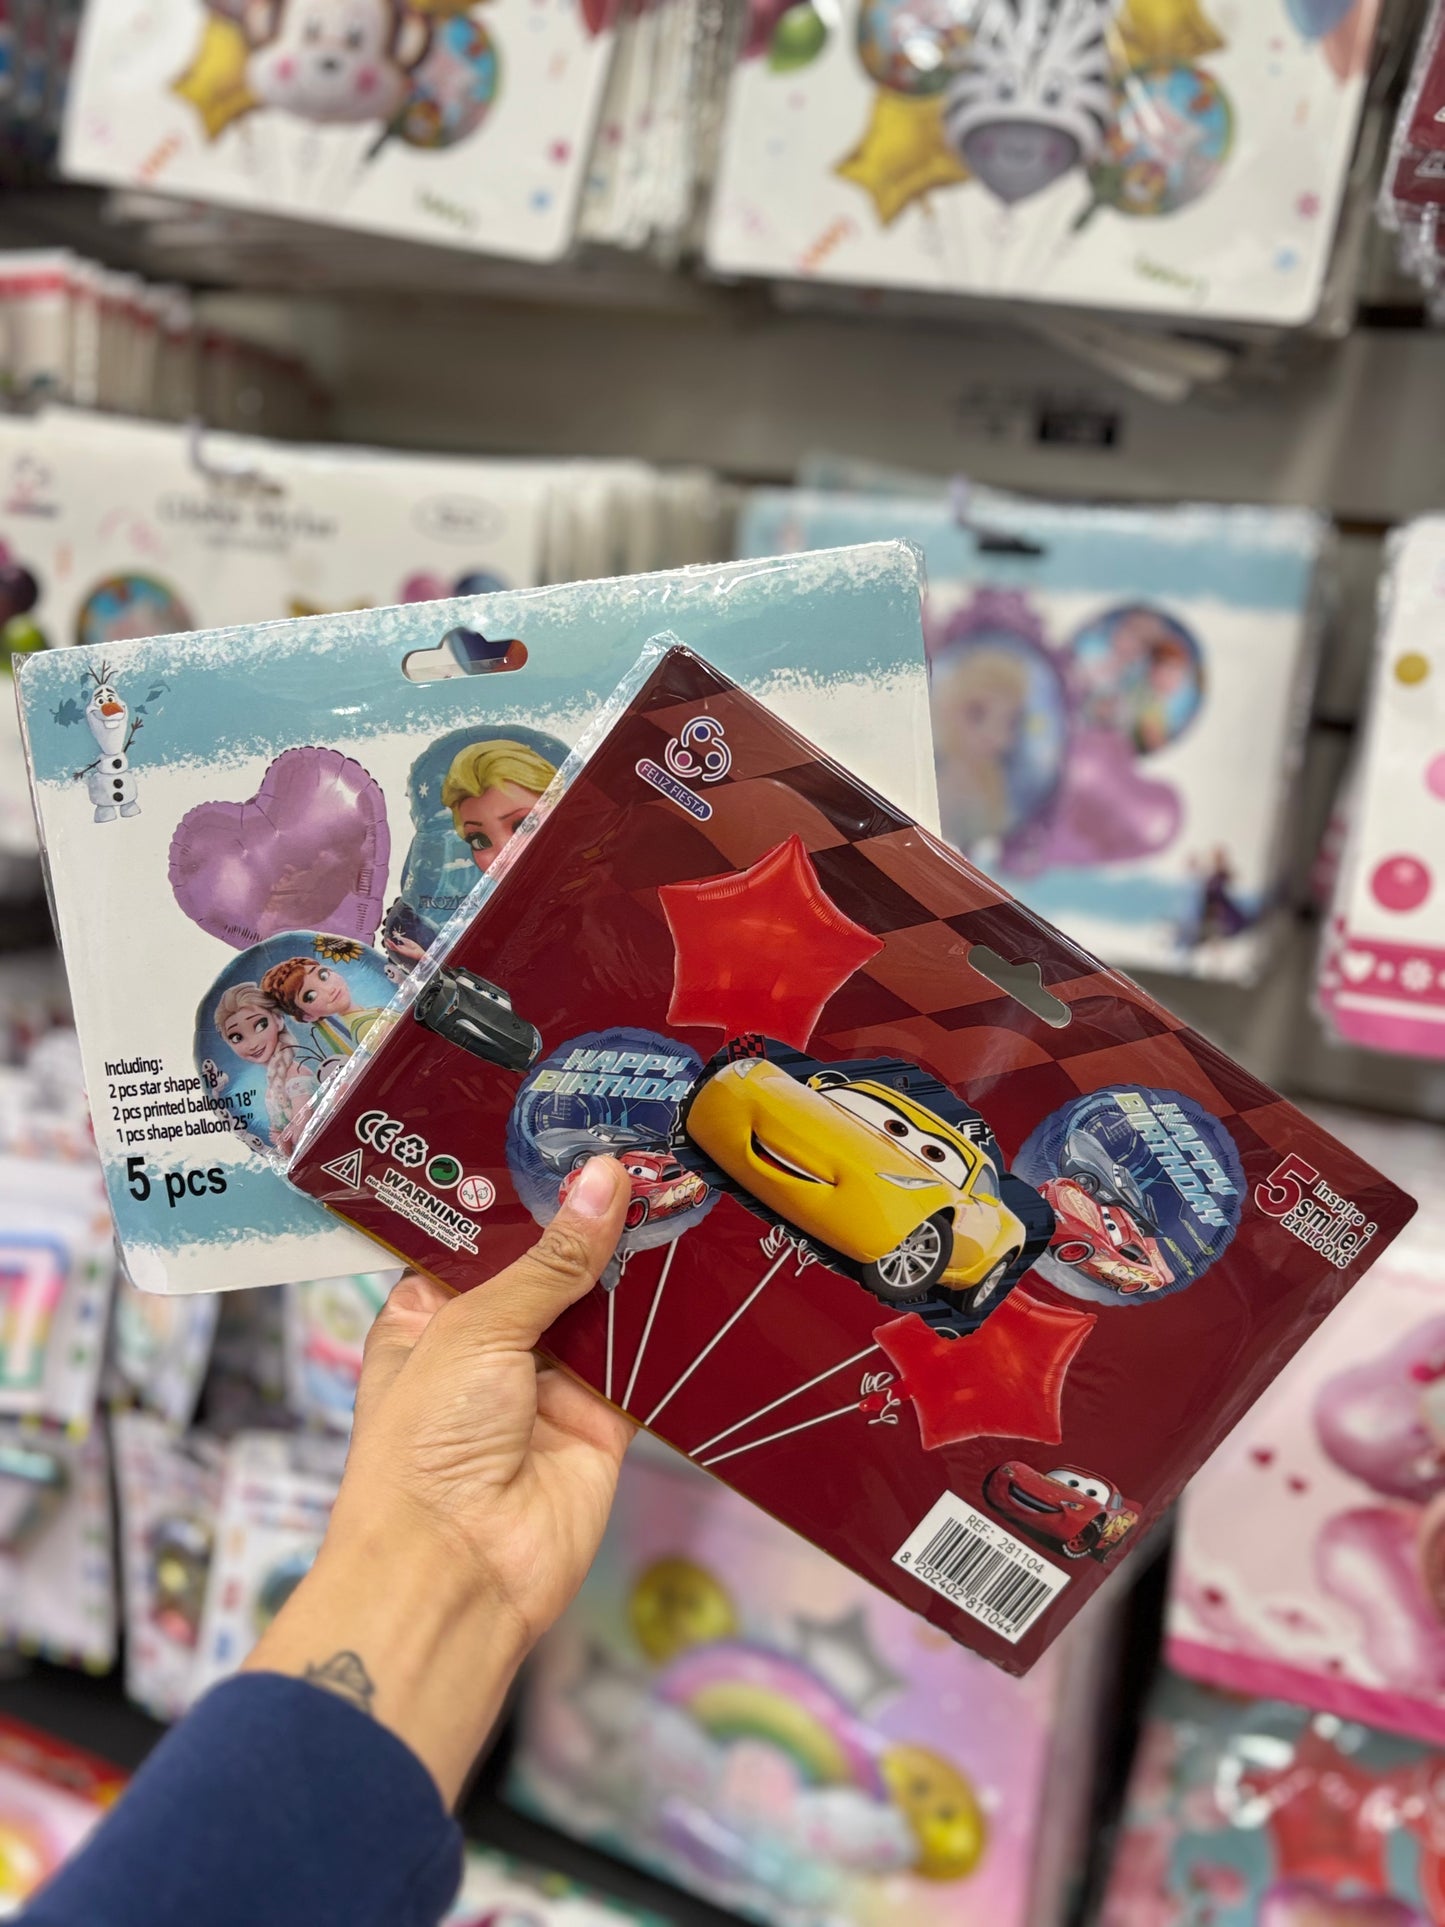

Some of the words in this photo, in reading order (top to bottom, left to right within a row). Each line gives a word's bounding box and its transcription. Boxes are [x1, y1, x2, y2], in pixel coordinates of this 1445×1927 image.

[640, 763, 672, 789] FELIZ
[670, 785, 705, 816] FIESTA
[105, 1057, 163, 1076] Including:
[108, 1084, 117, 1098] 2
[119, 1084, 138, 1101] pcs
[140, 1080, 161, 1095] star
[164, 1076, 201, 1095] shape
[561, 1048, 692, 1078] HAPPY
[112, 1106, 120, 1121] 2
[122, 1106, 142, 1123] pcs
[144, 1098, 186, 1121] printed
[187, 1095, 234, 1113] balloon
[116, 1128, 124, 1143] 1
[126, 1129, 146, 1146] pcs
[147, 1124, 183, 1142] shape
[184, 1118, 232, 1136] balloon
[1112, 1092, 1231, 1227] BIRTHDAY
[1151, 1103, 1239, 1196] HAPPY
[126, 1156, 151, 1201] 5
[165, 1167, 227, 1208] pcs
[366, 1176, 379, 1188] Not
[379, 1183, 403, 1203] suitable
[403, 1198, 414, 1210] for
[413, 1205, 438, 1226] children
[437, 1222, 456, 1238] under
[376, 1193, 394, 1208] small
[384, 1169, 480, 1239] WARNING!
[1254, 1152, 1320, 1217] 5
[1313, 1181, 1365, 1225] inspire
[1364, 1222, 1377, 1236] a
[1281, 1213, 1350, 1268] BALLOONS
[1295, 1200, 1370, 1257] smile!
[965, 1514, 995, 1540] REF:
[997, 1537, 1045, 1574] 281104
[900, 1551, 912, 1564] 8
[914, 1560, 965, 1601] 202402
[965, 1597, 1014, 1634] 811044
